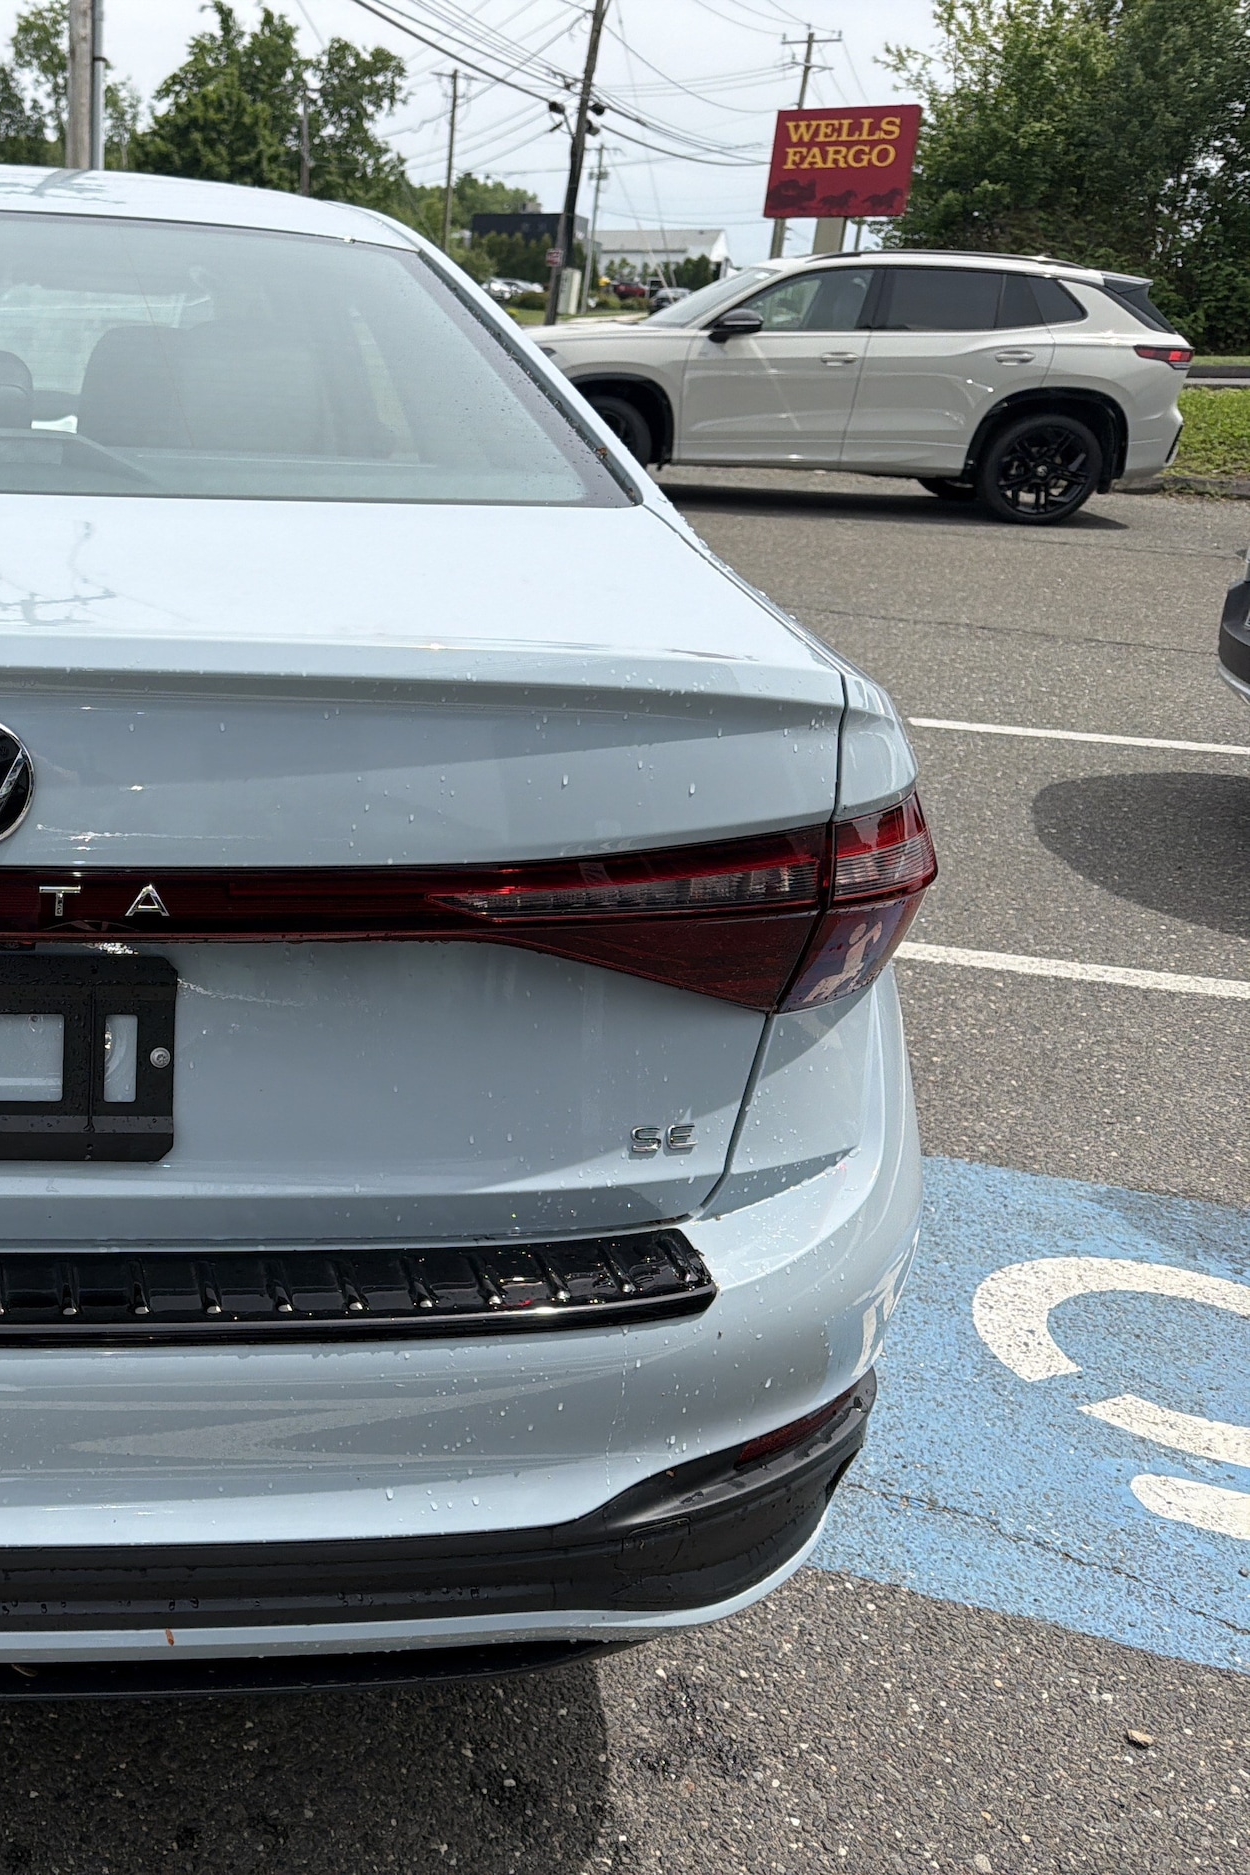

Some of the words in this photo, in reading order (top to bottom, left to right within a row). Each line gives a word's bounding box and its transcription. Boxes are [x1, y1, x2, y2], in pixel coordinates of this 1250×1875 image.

[786, 117, 901, 142] WELLS
[782, 144, 896, 169] FARGO
[630, 1123, 698, 1152] SE
